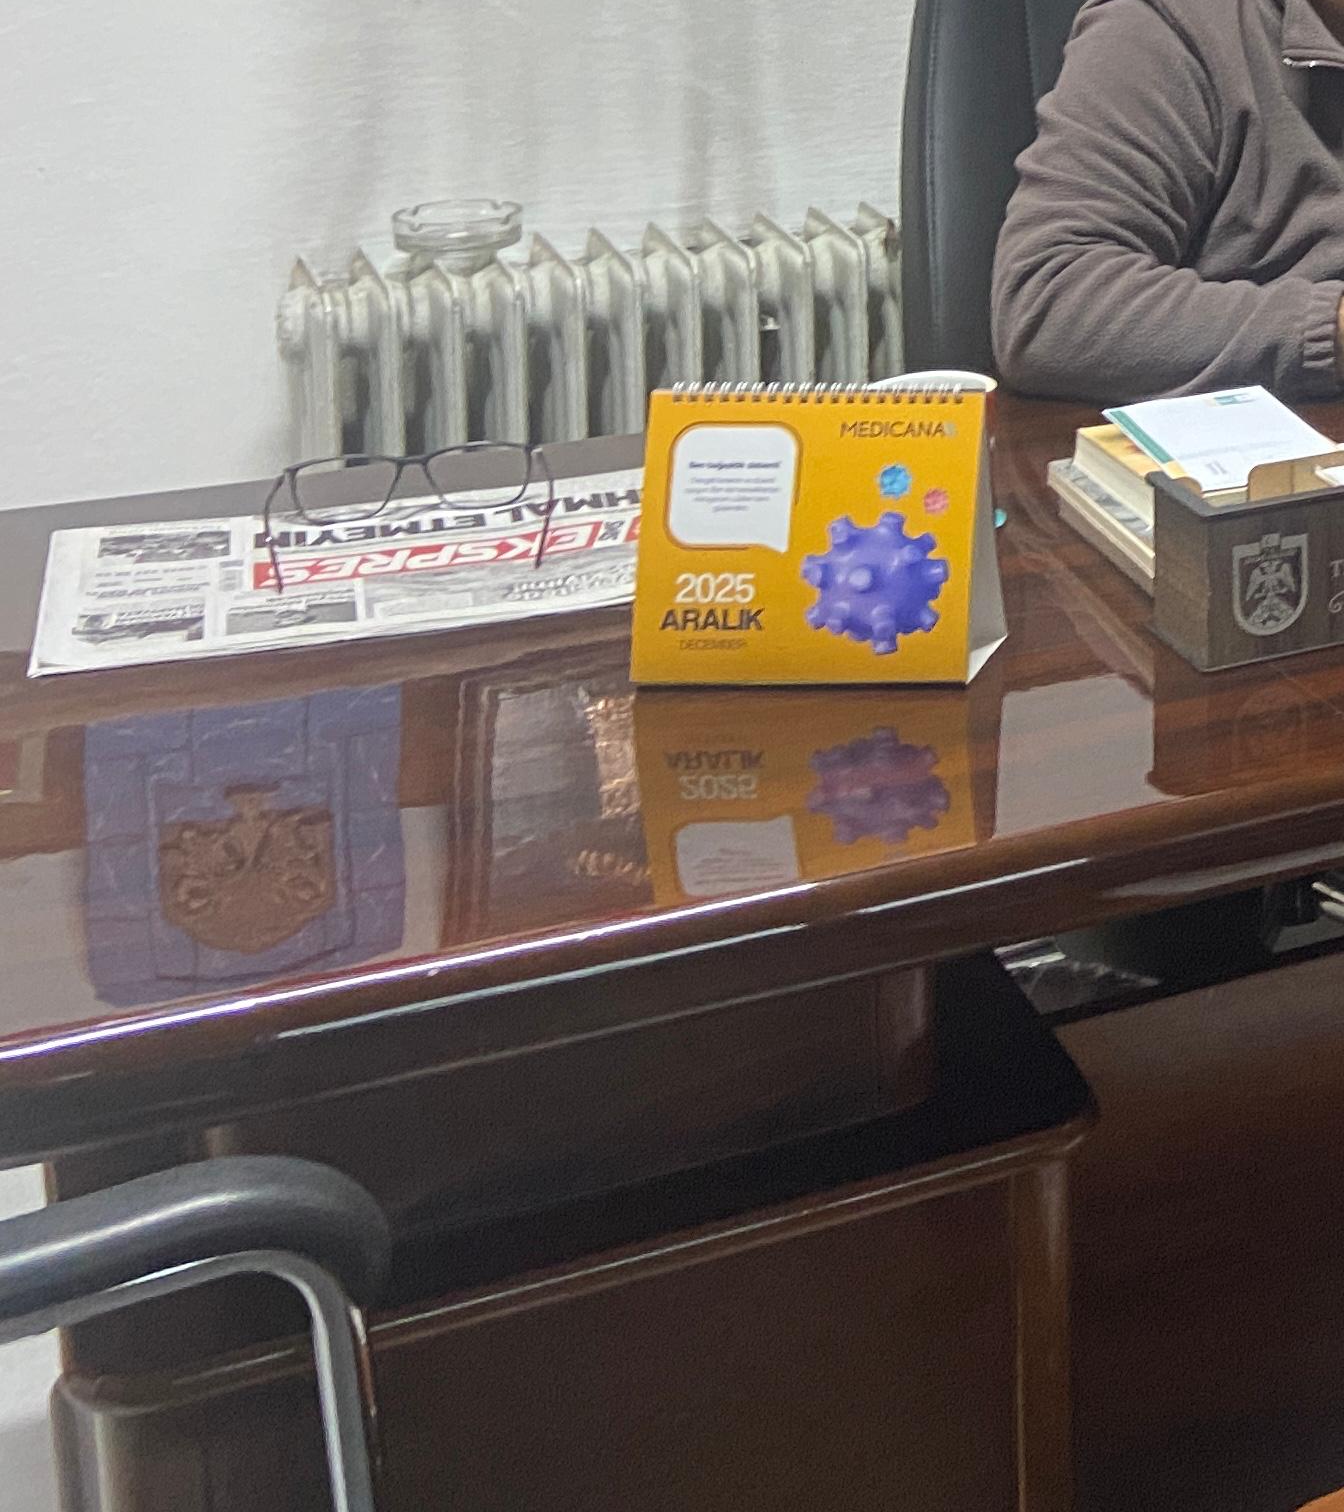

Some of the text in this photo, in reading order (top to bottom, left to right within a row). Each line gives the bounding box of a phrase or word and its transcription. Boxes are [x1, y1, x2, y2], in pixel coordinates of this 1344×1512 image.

[840, 420, 948, 439] MEDICANA
[495, 490, 640, 525] HMAL
[674, 572, 756, 605] 2025
[659, 606, 766, 632] ARALIK
